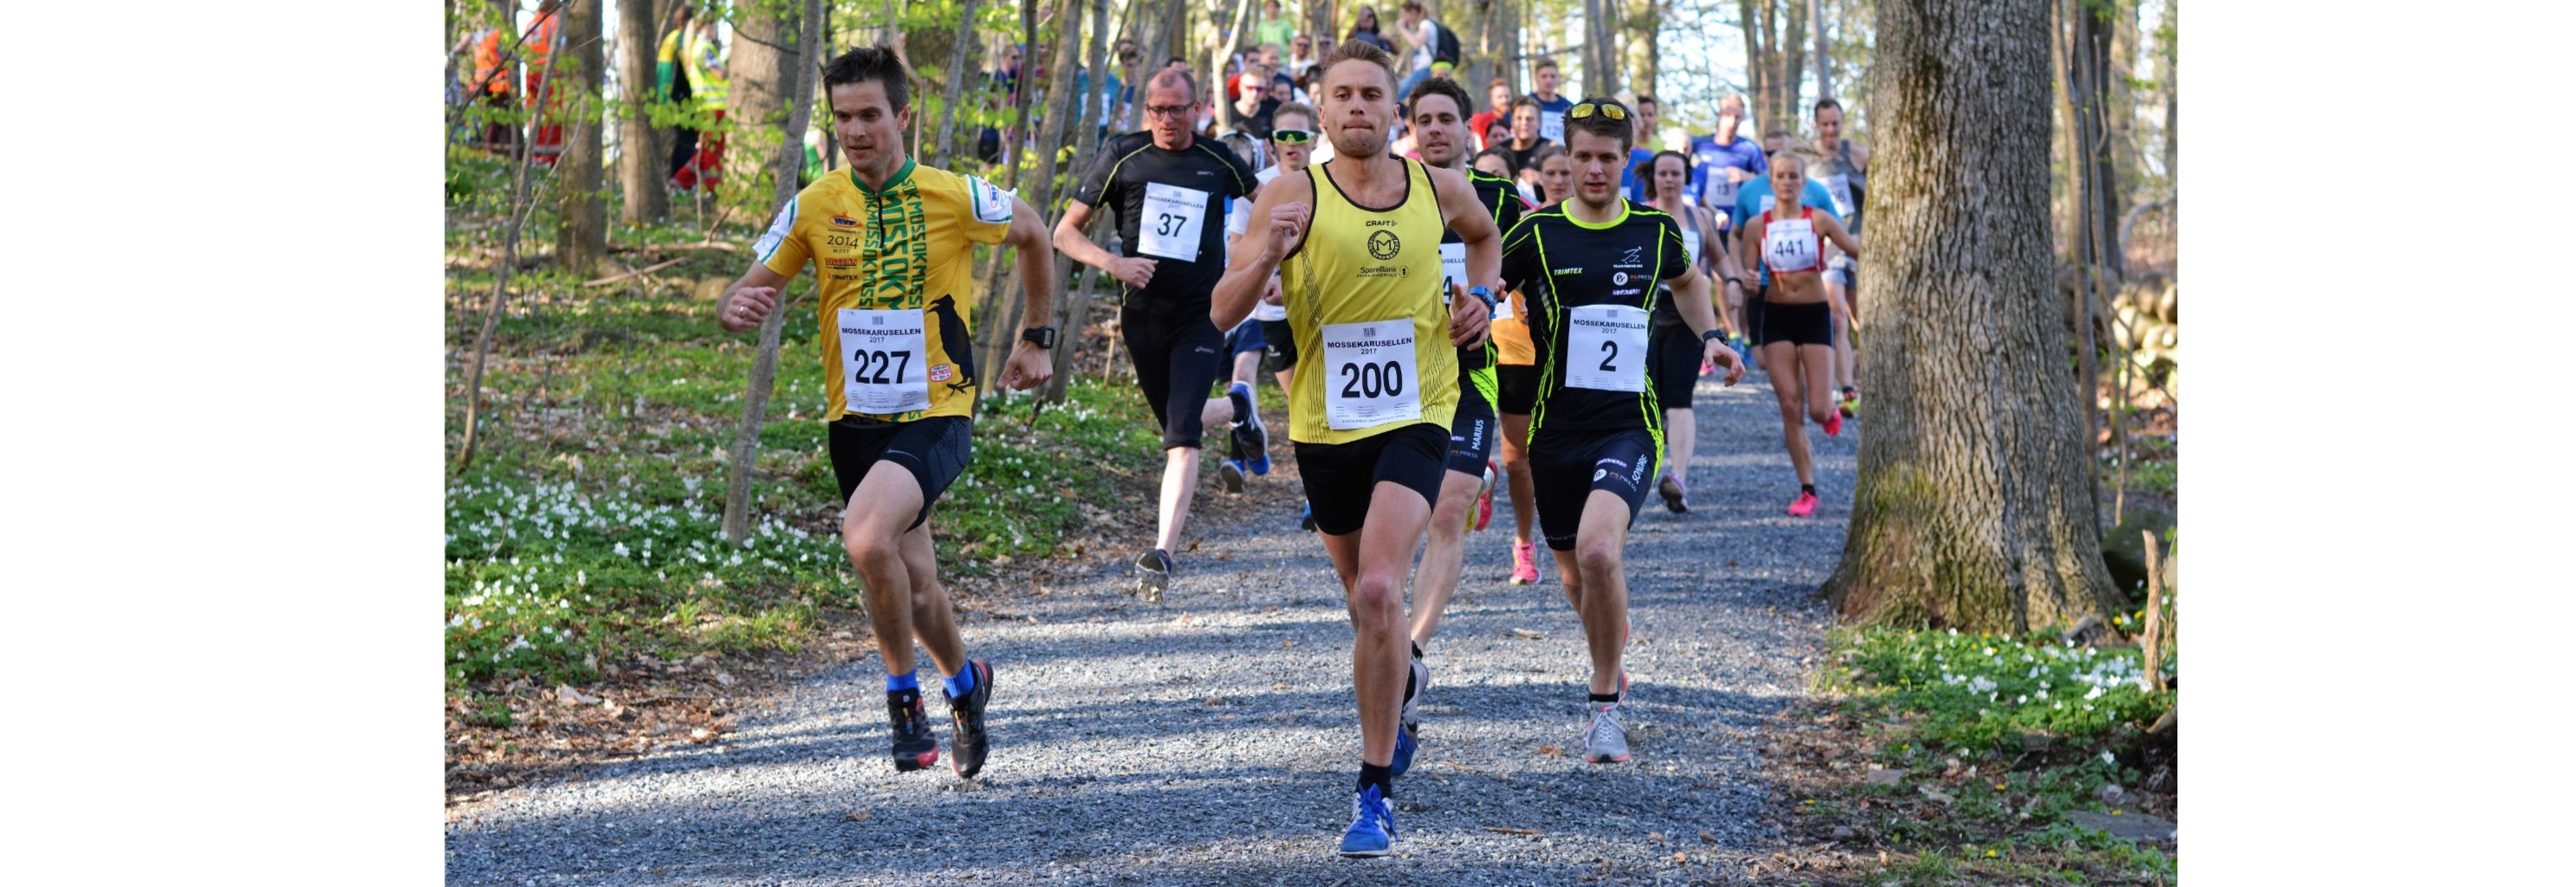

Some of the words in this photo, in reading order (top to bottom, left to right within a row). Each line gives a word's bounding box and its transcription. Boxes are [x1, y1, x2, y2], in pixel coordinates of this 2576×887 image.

[1147, 195, 1204, 209] MOSSEKARUSELLEN
[1157, 212, 1188, 238] 37
[827, 235, 860, 249] 2014
[1375, 239, 1392, 251] M
[1775, 240, 1804, 257] 441
[1360, 266, 1397, 275] SpareBank
[841, 327, 922, 336] MOSSEKARUSELLEN
[1573, 319, 1646, 330] MOSSEKARUSELLEN
[1327, 337, 1412, 348] MOSSEKARUSELLEN
[1599, 340, 1619, 372] 2
[854, 349, 911, 385] 227
[1341, 360, 1403, 398] 200
[1471, 419, 1484, 450] MARIUS
[1632, 454, 1649, 484] SONDRE
